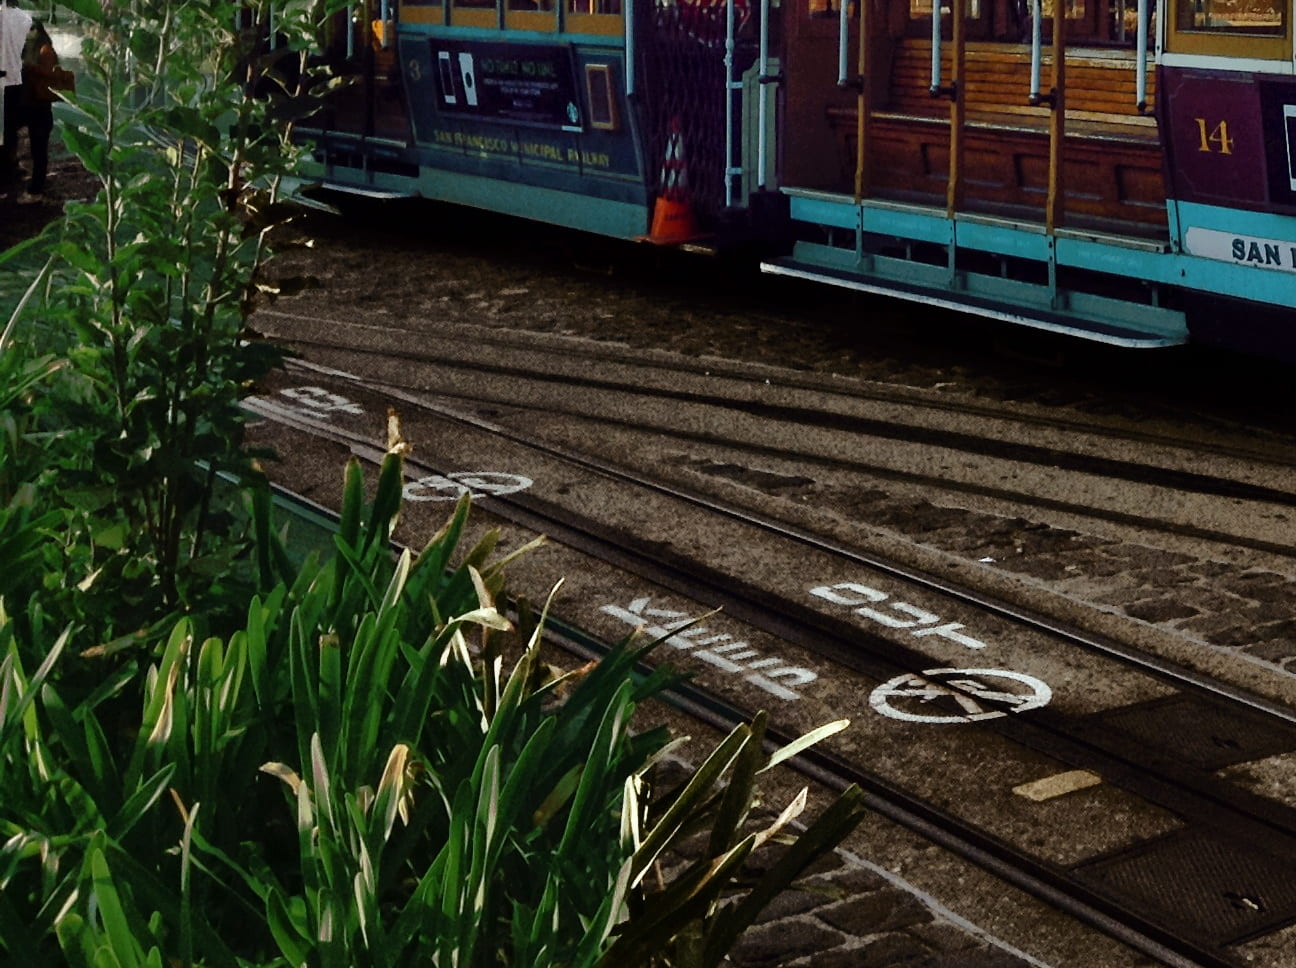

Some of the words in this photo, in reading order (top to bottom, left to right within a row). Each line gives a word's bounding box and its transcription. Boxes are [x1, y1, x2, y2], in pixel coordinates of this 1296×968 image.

[409, 58, 422, 81] 3
[433, 128, 452, 143] SAN
[1194, 117, 1234, 155] 14
[1232, 237, 1282, 268] SAN
